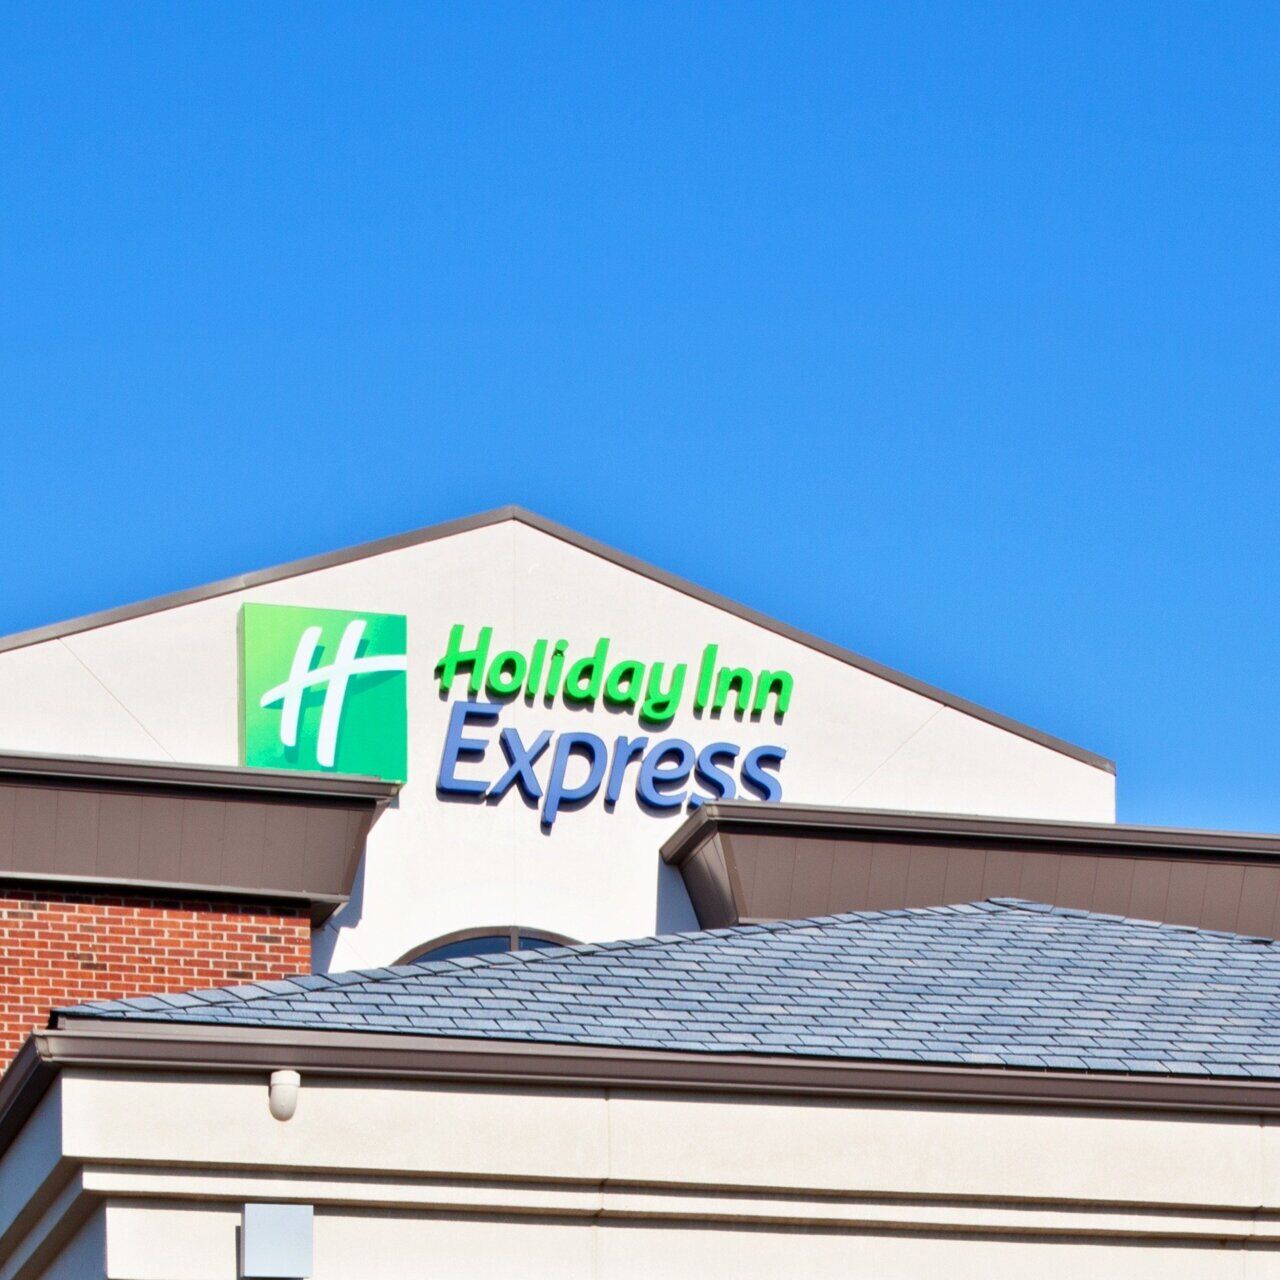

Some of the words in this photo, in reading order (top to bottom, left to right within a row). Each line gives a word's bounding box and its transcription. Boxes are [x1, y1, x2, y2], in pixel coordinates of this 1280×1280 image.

[434, 624, 688, 724] Holiday
[693, 643, 793, 716] Inn
[435, 700, 788, 827] Express
